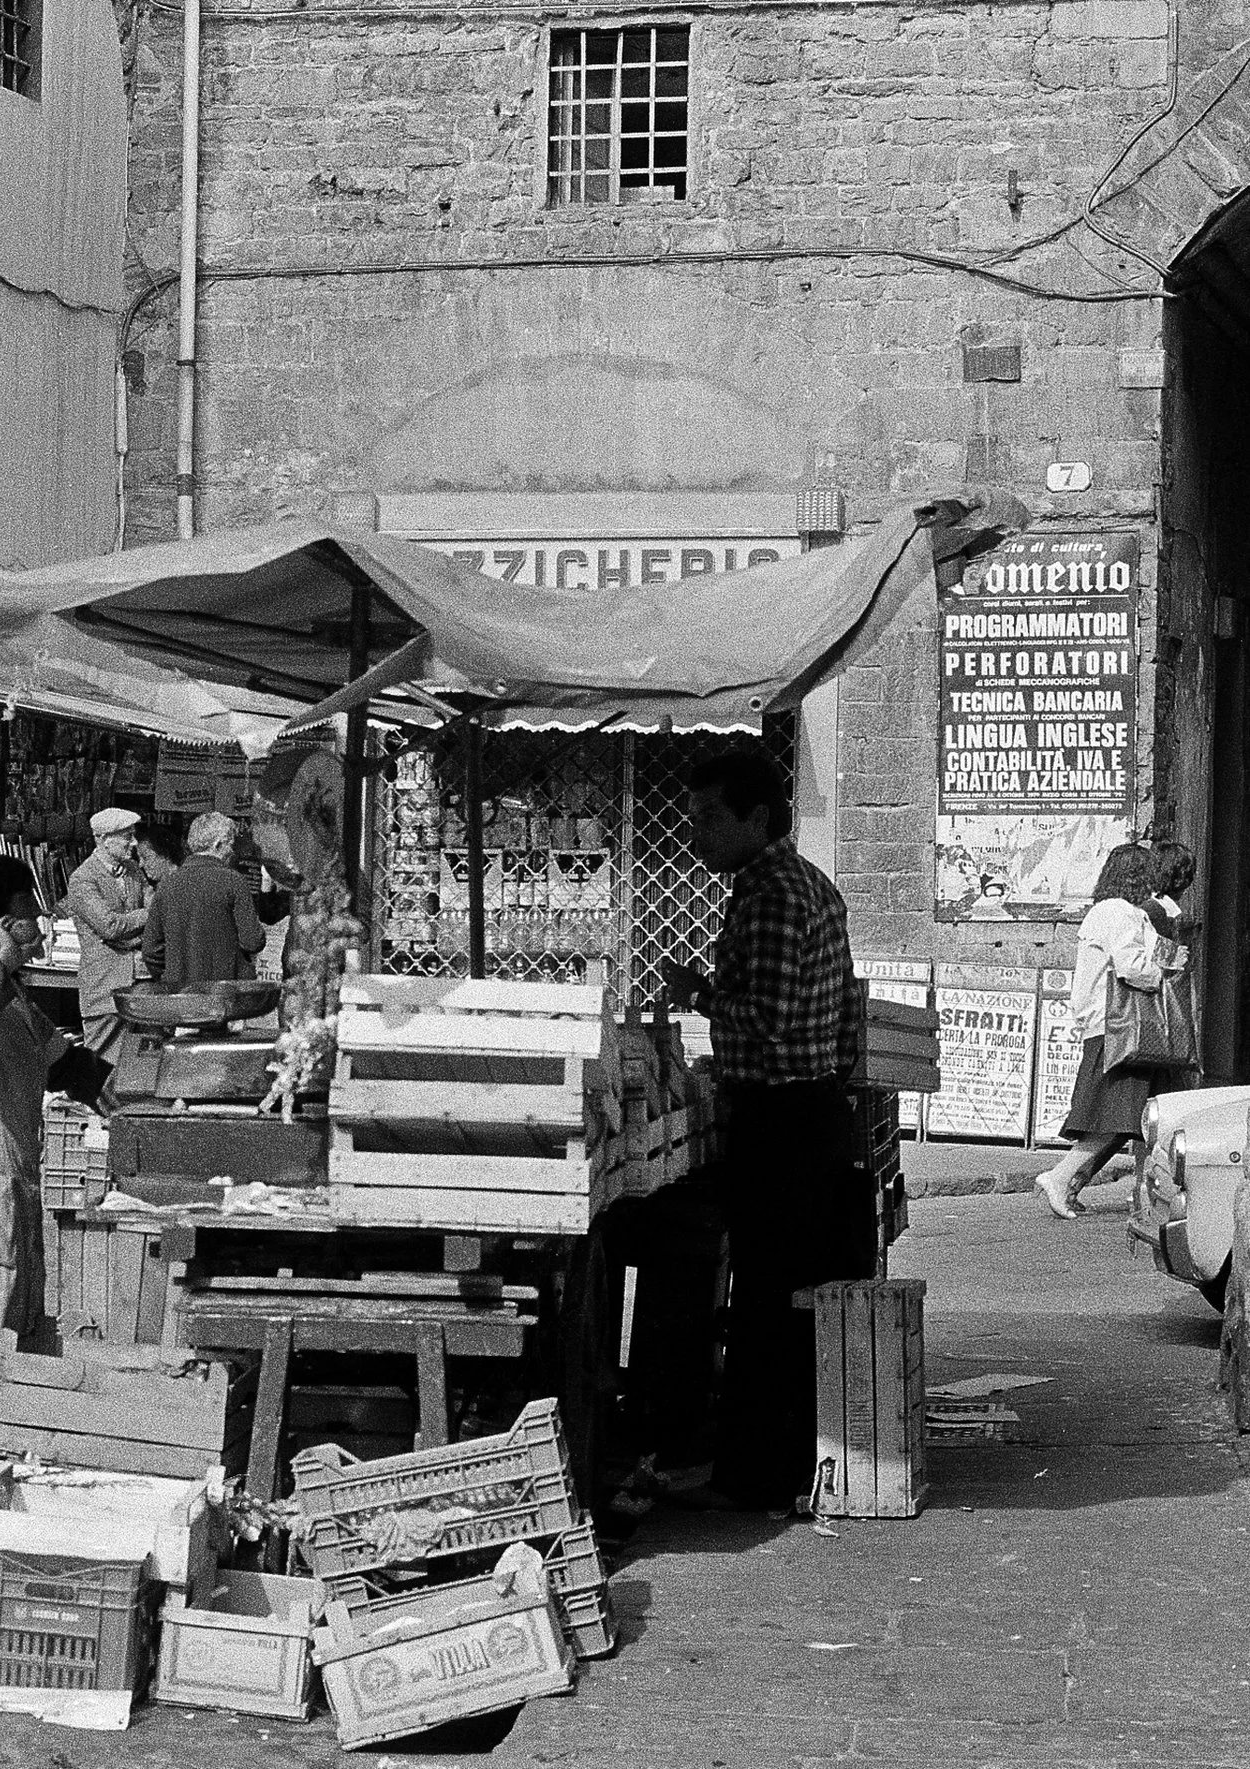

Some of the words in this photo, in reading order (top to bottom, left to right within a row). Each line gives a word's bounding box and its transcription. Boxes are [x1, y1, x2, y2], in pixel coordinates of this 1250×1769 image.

[1060, 465, 1075, 487] 7
[1030, 542, 1044, 553] di
[451, 548, 780, 590] ZICHER
[986, 560, 1130, 594] omenio
[945, 612, 1128, 638] PROGRAMMATORI
[945, 650, 1128, 676] PERFORATORI
[975, 679, 983, 687] di
[984, 678, 1016, 687] SCHEDE
[1018, 677, 1100, 686] MECCANOGRAFICHE
[950, 690, 1027, 712] TECNICA
[1032, 689, 1124, 712] BANCARIA
[945, 723, 1028, 749] LINGUA
[1037, 722, 1128, 748] INGLESE
[947, 747, 1072, 772] CONTABILITÀ,
[1077, 749, 1105, 771] IVA
[1111, 749, 1123, 770] E
[944, 770, 1022, 792] PRATICA
[1026, 769, 1127, 791] AZIENDALE
[945, 803, 979, 811] FIRENZE
[941, 990, 961, 1003] LA
[964, 992, 1032, 1010] NAZIONE
[941, 1008, 1029, 1034] SFRATTI:
[969, 1031, 980, 1045] LA
[985, 1033, 1026, 1050] PROROGA
[1047, 1044, 1063, 1052] LA
[431, 1639, 491, 1681] VILLA
